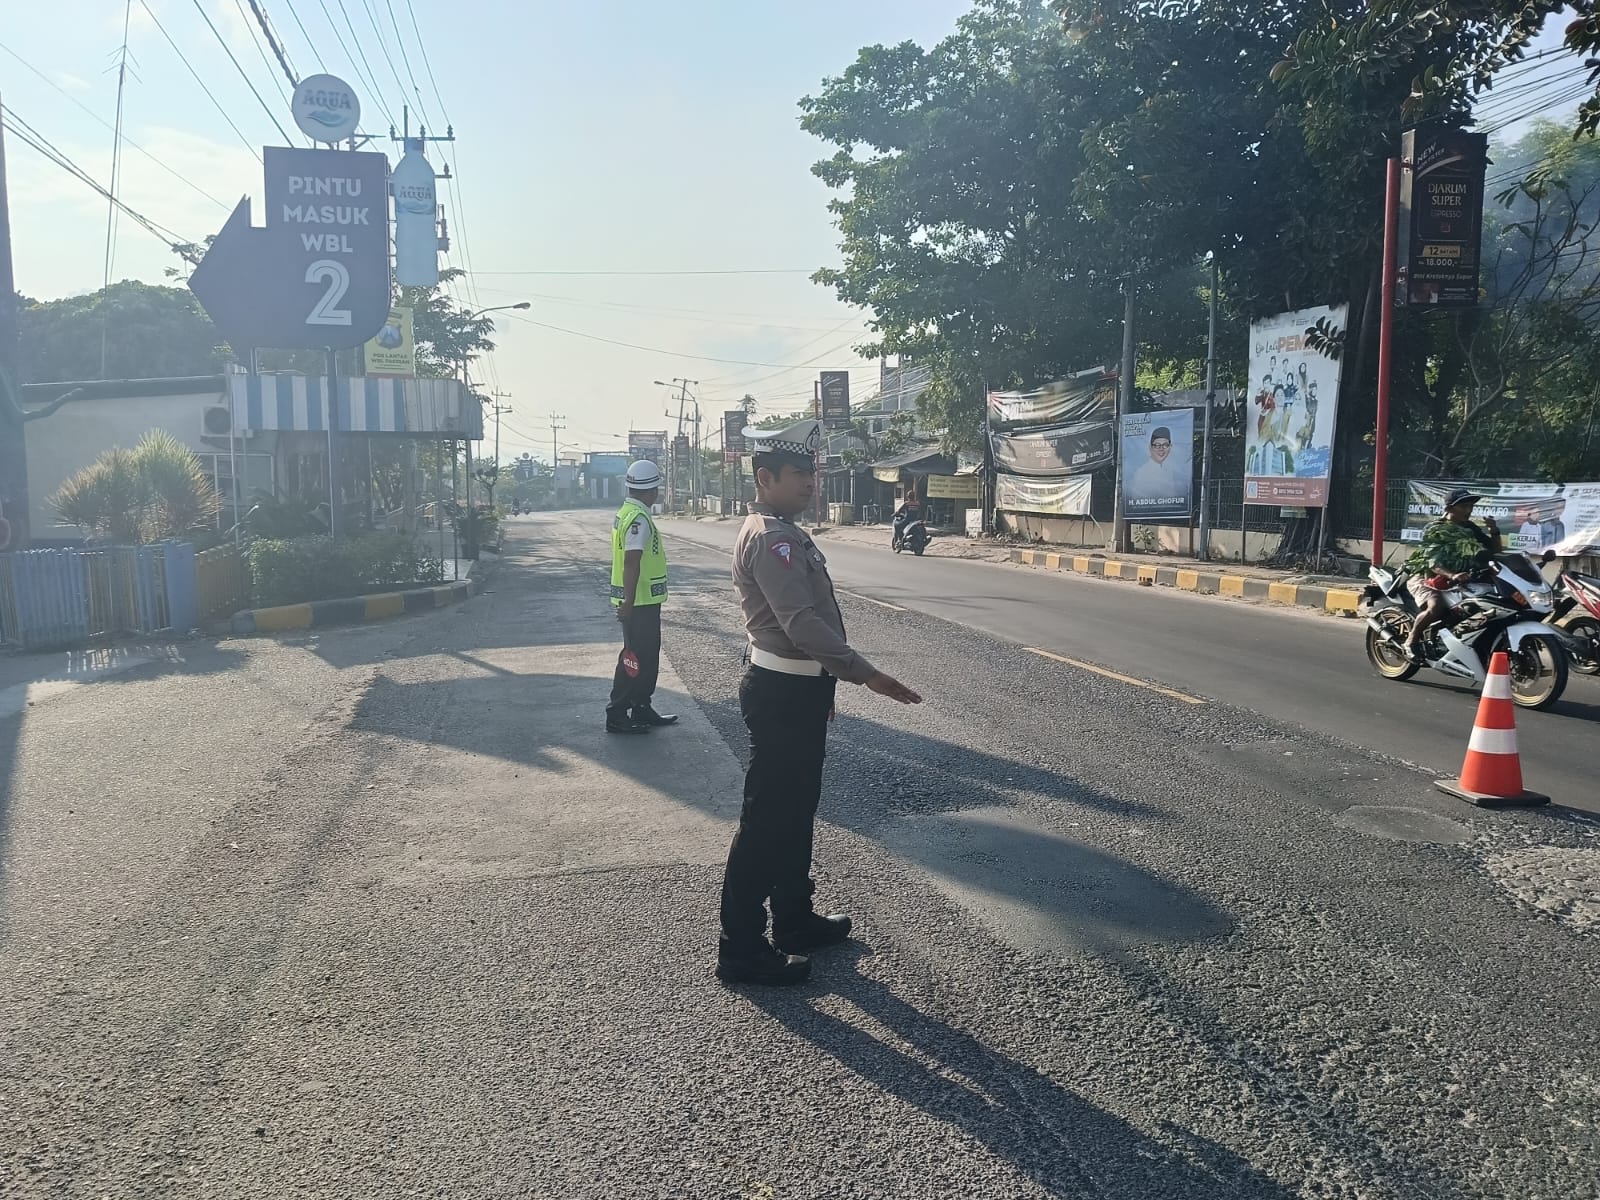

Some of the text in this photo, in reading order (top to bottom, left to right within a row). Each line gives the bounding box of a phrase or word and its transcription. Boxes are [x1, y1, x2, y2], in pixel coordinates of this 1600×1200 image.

[302, 89, 352, 110] AQUA
[1417, 142, 1437, 165] NEW
[289, 176, 362, 196] PINTU
[399, 185, 433, 201] AQUA
[1428, 183, 1467, 194] DJARUM
[1431, 195, 1462, 206] SUPER
[283, 204, 369, 226] MASUK
[1430, 209, 1463, 218] ESPRESSO
[300, 232, 353, 253] WBL
[1429, 246, 1440, 256] 12
[304, 259, 353, 326] 2
[1157, 497, 1185, 505] GHOFUR
